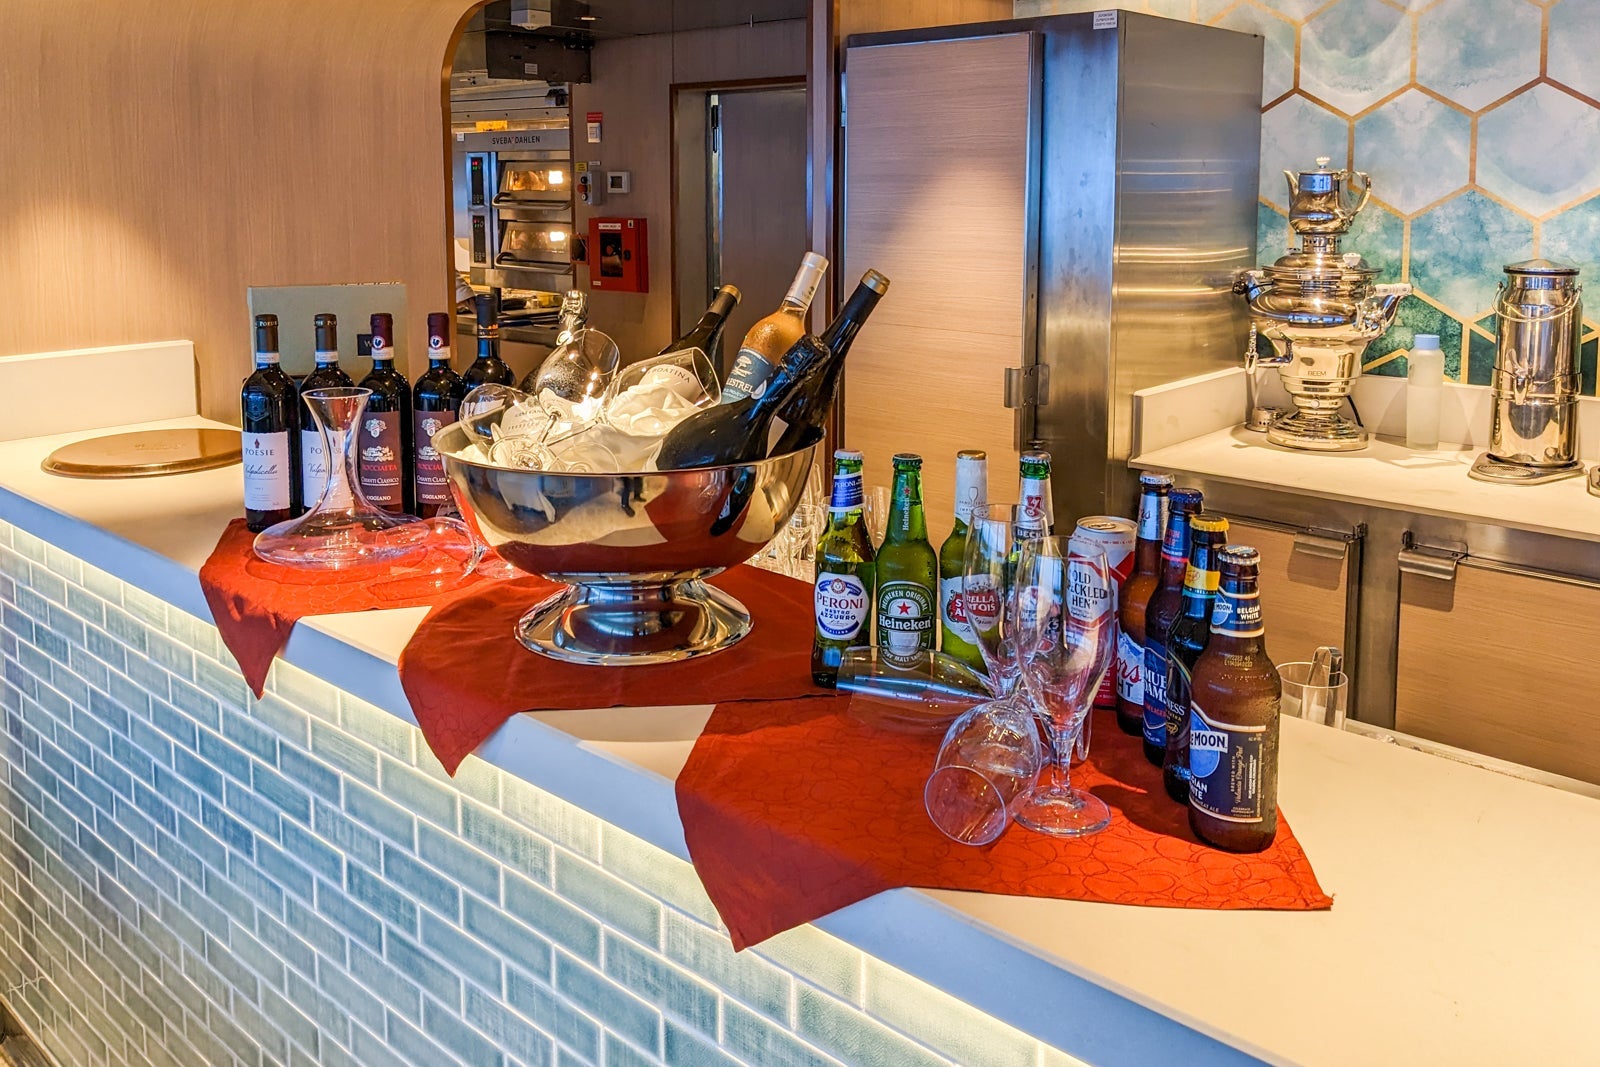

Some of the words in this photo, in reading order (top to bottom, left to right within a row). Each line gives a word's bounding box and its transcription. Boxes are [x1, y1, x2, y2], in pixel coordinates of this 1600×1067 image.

[492, 137, 512, 145] SVEBA
[514, 135, 541, 144] DAHLEN
[245, 447, 275, 456] POESIE
[377, 476, 400, 485] CLASSICO
[834, 480, 857, 488] PERONI
[902, 497, 910, 532] Heineken
[1071, 569, 1091, 585] OLD
[816, 591, 864, 610] PERONI
[881, 590, 904, 610] HEINEKEN
[905, 590, 929, 611] ORIGINAL
[1237, 604, 1260, 614] BELGIAN
[820, 610, 856, 621] AZZURRO
[1240, 612, 1259, 620] WHITE
[879, 614, 931, 631] Heineken
[1195, 732, 1226, 750] MOON
[1209, 805, 1220, 813] ALE
